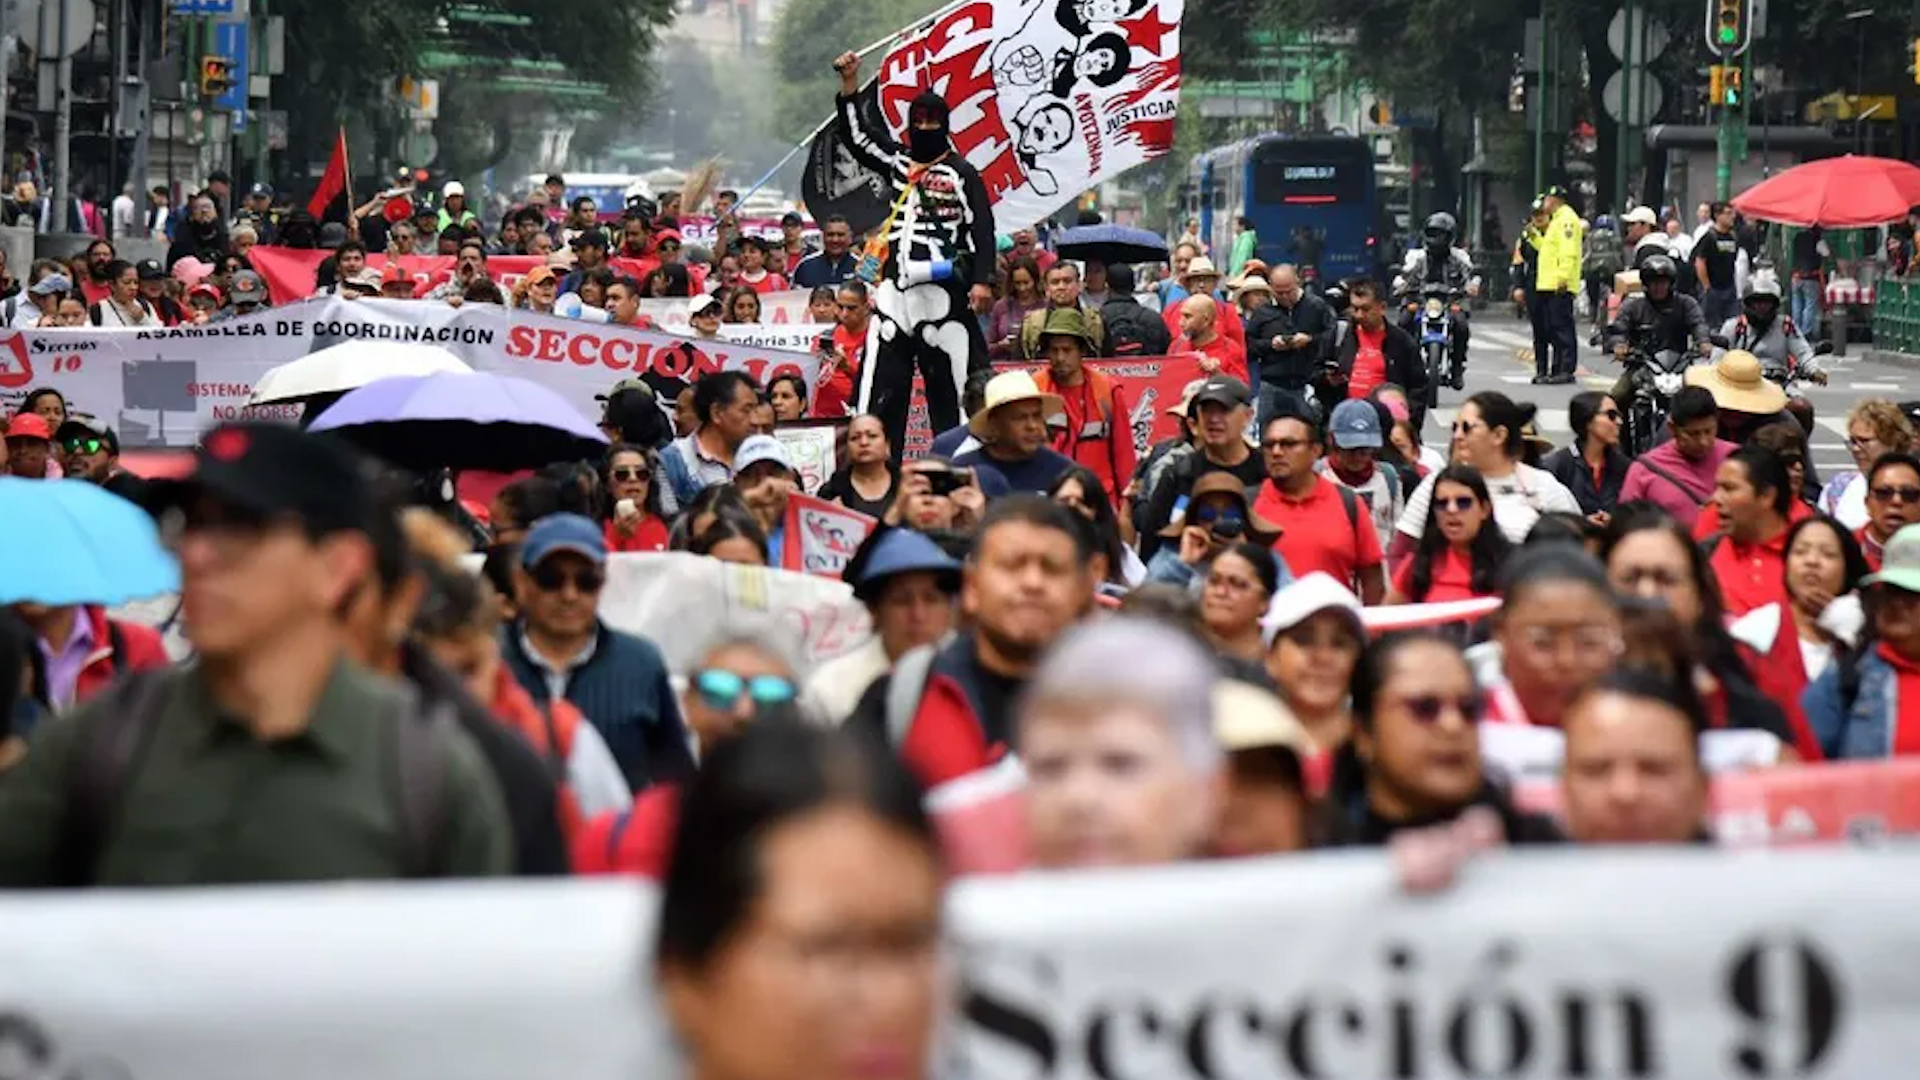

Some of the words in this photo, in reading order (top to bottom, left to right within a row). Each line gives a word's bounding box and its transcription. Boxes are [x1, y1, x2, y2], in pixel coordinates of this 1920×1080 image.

[926, 2, 1027, 205] CNTE
[1106, 100, 1175, 135] JUSTICIA
[136, 322, 267, 340] ASAMBLEA
[277, 321, 303, 336] DE
[313, 321, 494, 344] COORDINACIÓN
[730, 335, 787, 347] ndaria
[53, 354, 83, 373] 10
[505, 325, 728, 382] SECCIÓN
[186, 382, 251, 397] SISTEMA
[213, 405, 235, 420] NO
[242, 404, 299, 419] AFORES
[953, 944, 1660, 1080] Sección
[1722, 934, 1847, 1079] 9
